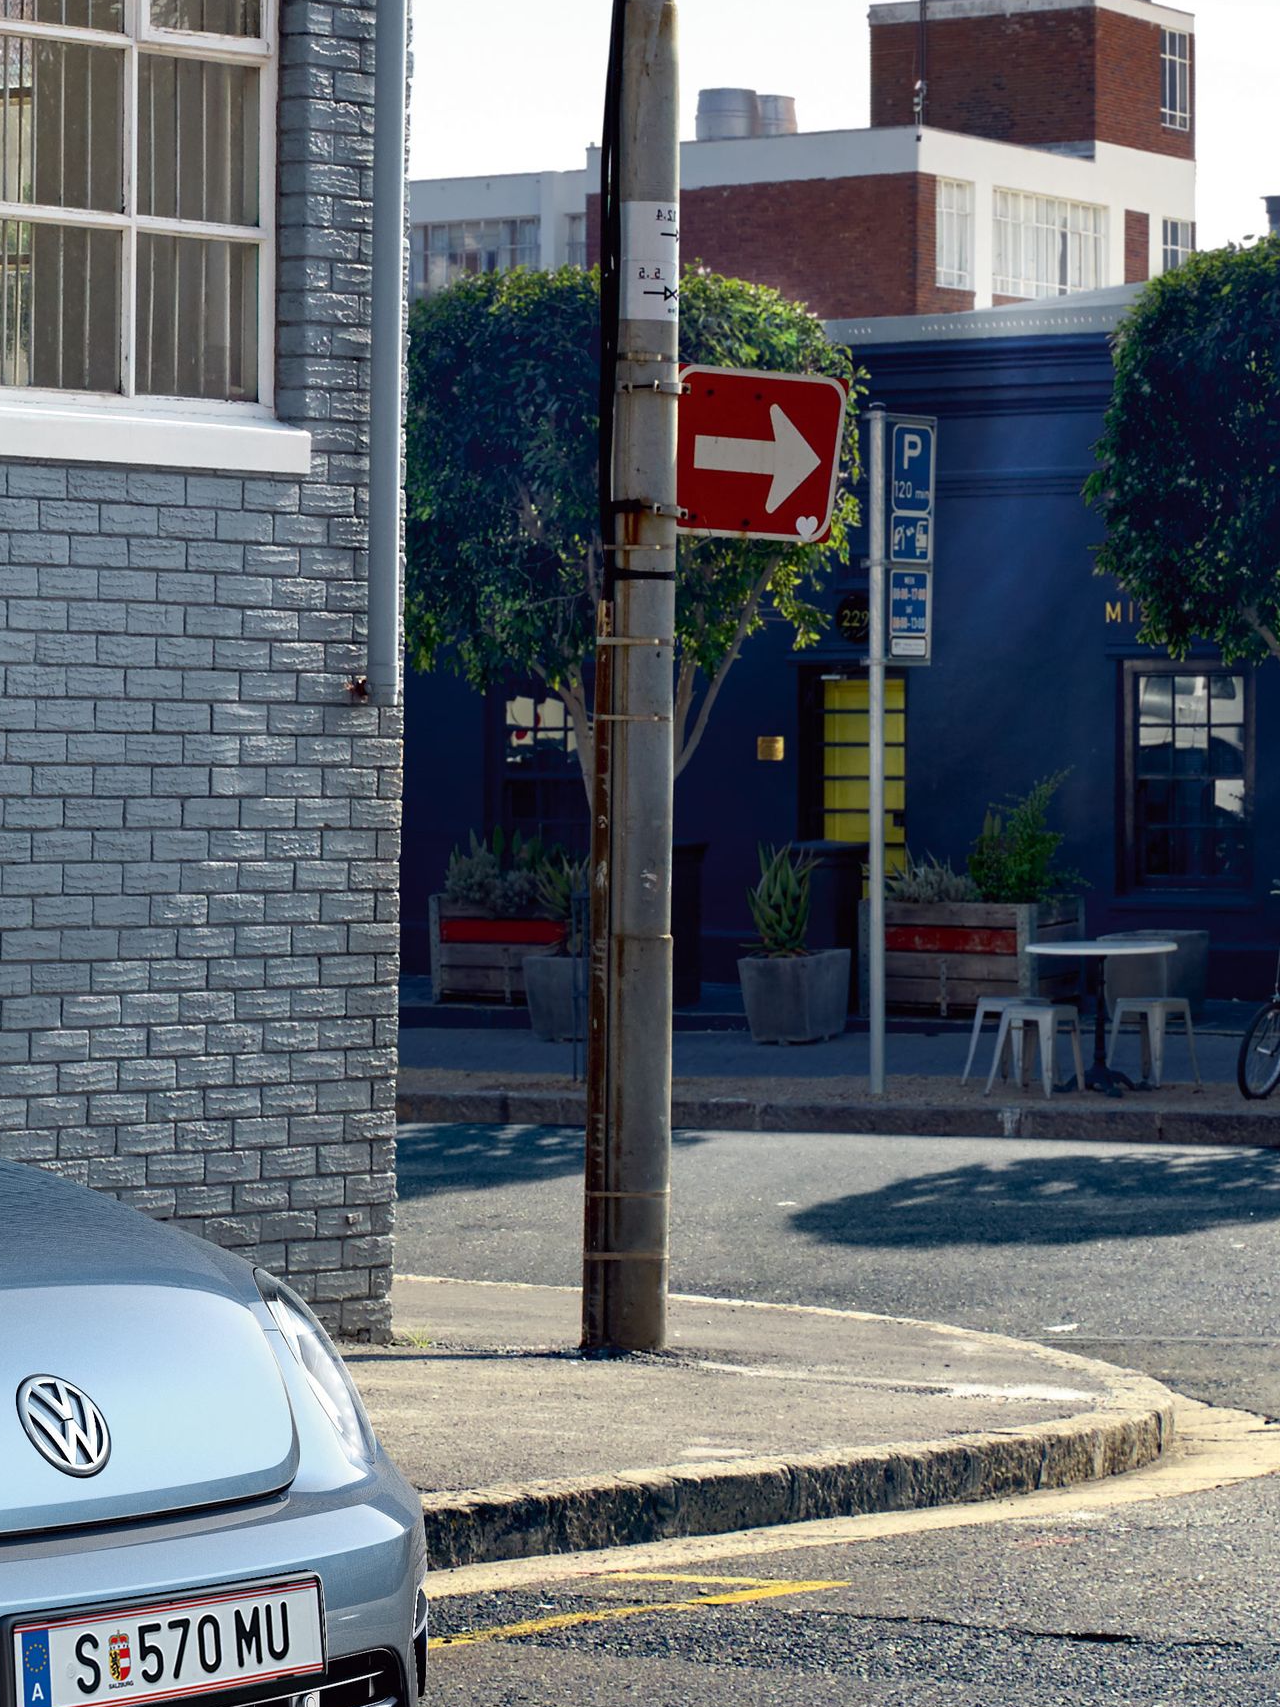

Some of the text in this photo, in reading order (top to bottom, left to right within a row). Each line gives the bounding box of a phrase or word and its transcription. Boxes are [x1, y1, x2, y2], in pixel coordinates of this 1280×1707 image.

[903, 434, 922, 470] P
[893, 481, 913, 499] 120
[842, 609, 870, 628] 229
[74, 1600, 290, 1695] S 570 MU
[31, 1682, 45, 1702] A
[108, 1679, 135, 1691] SALZBURG
